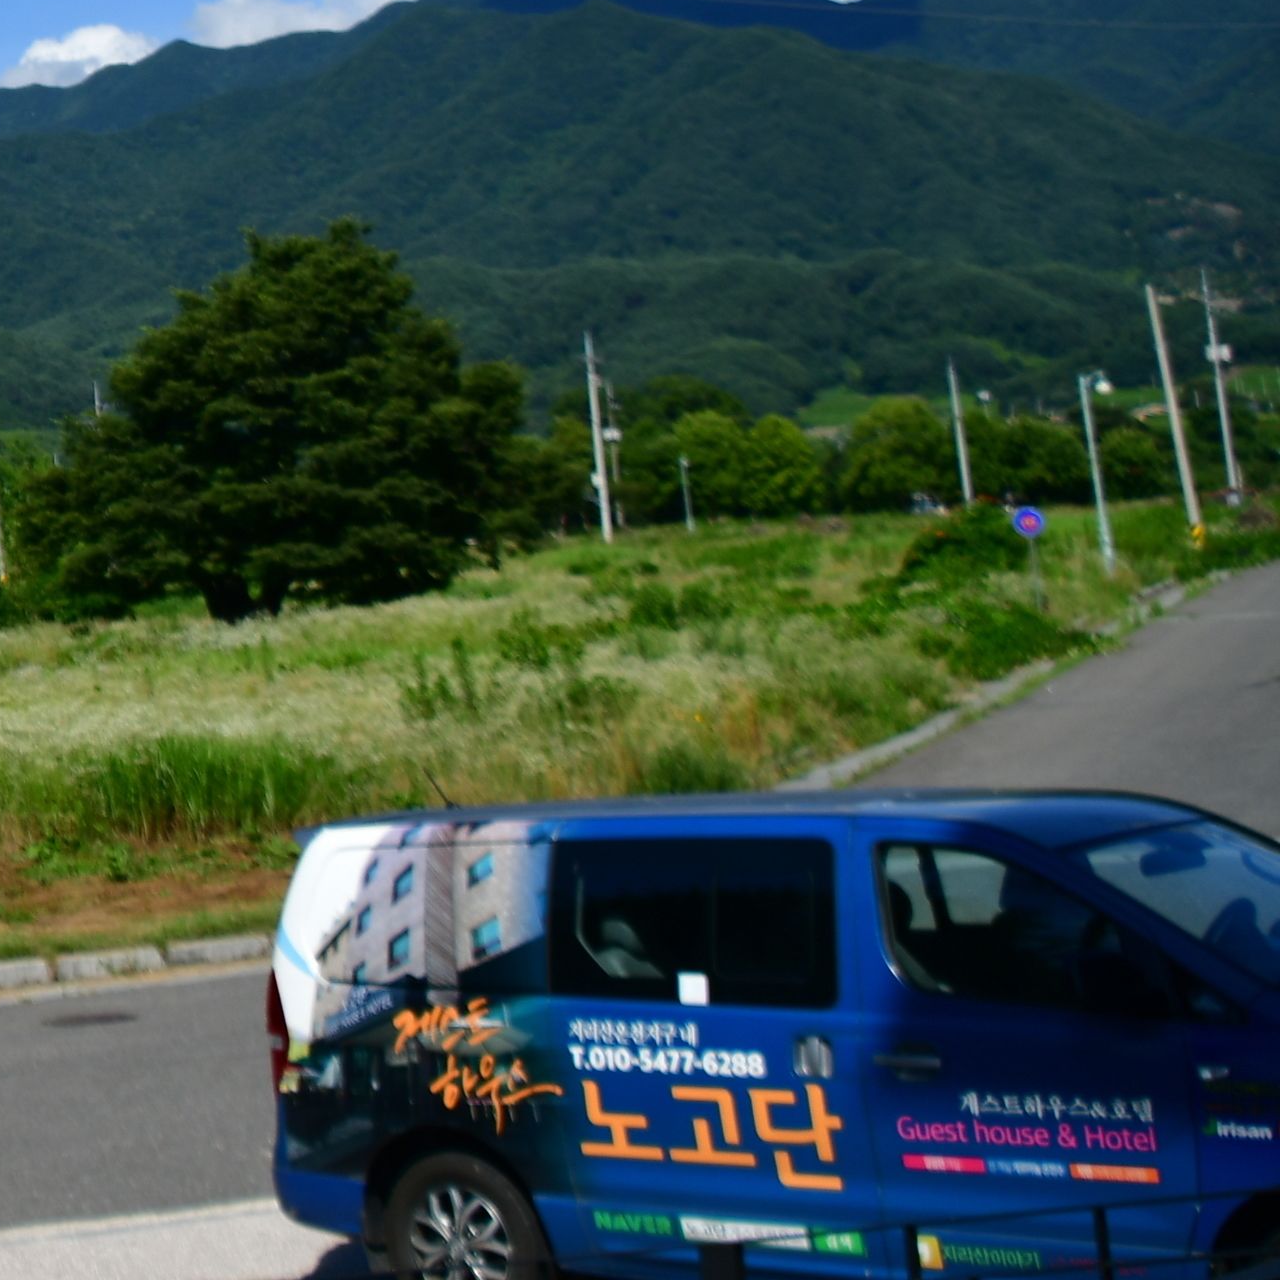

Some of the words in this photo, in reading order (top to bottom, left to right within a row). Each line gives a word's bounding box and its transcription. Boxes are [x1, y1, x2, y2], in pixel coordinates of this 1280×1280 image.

[569, 1044, 768, 1079] T.010-5477-6288
[580, 1080, 844, 1191] 노고단
[896, 1116, 968, 1144] Guest
[974, 1119, 1050, 1147] house
[1057, 1123, 1078, 1149] &
[1085, 1126, 1158, 1152] Hotel
[593, 1210, 672, 1236] NAVER
